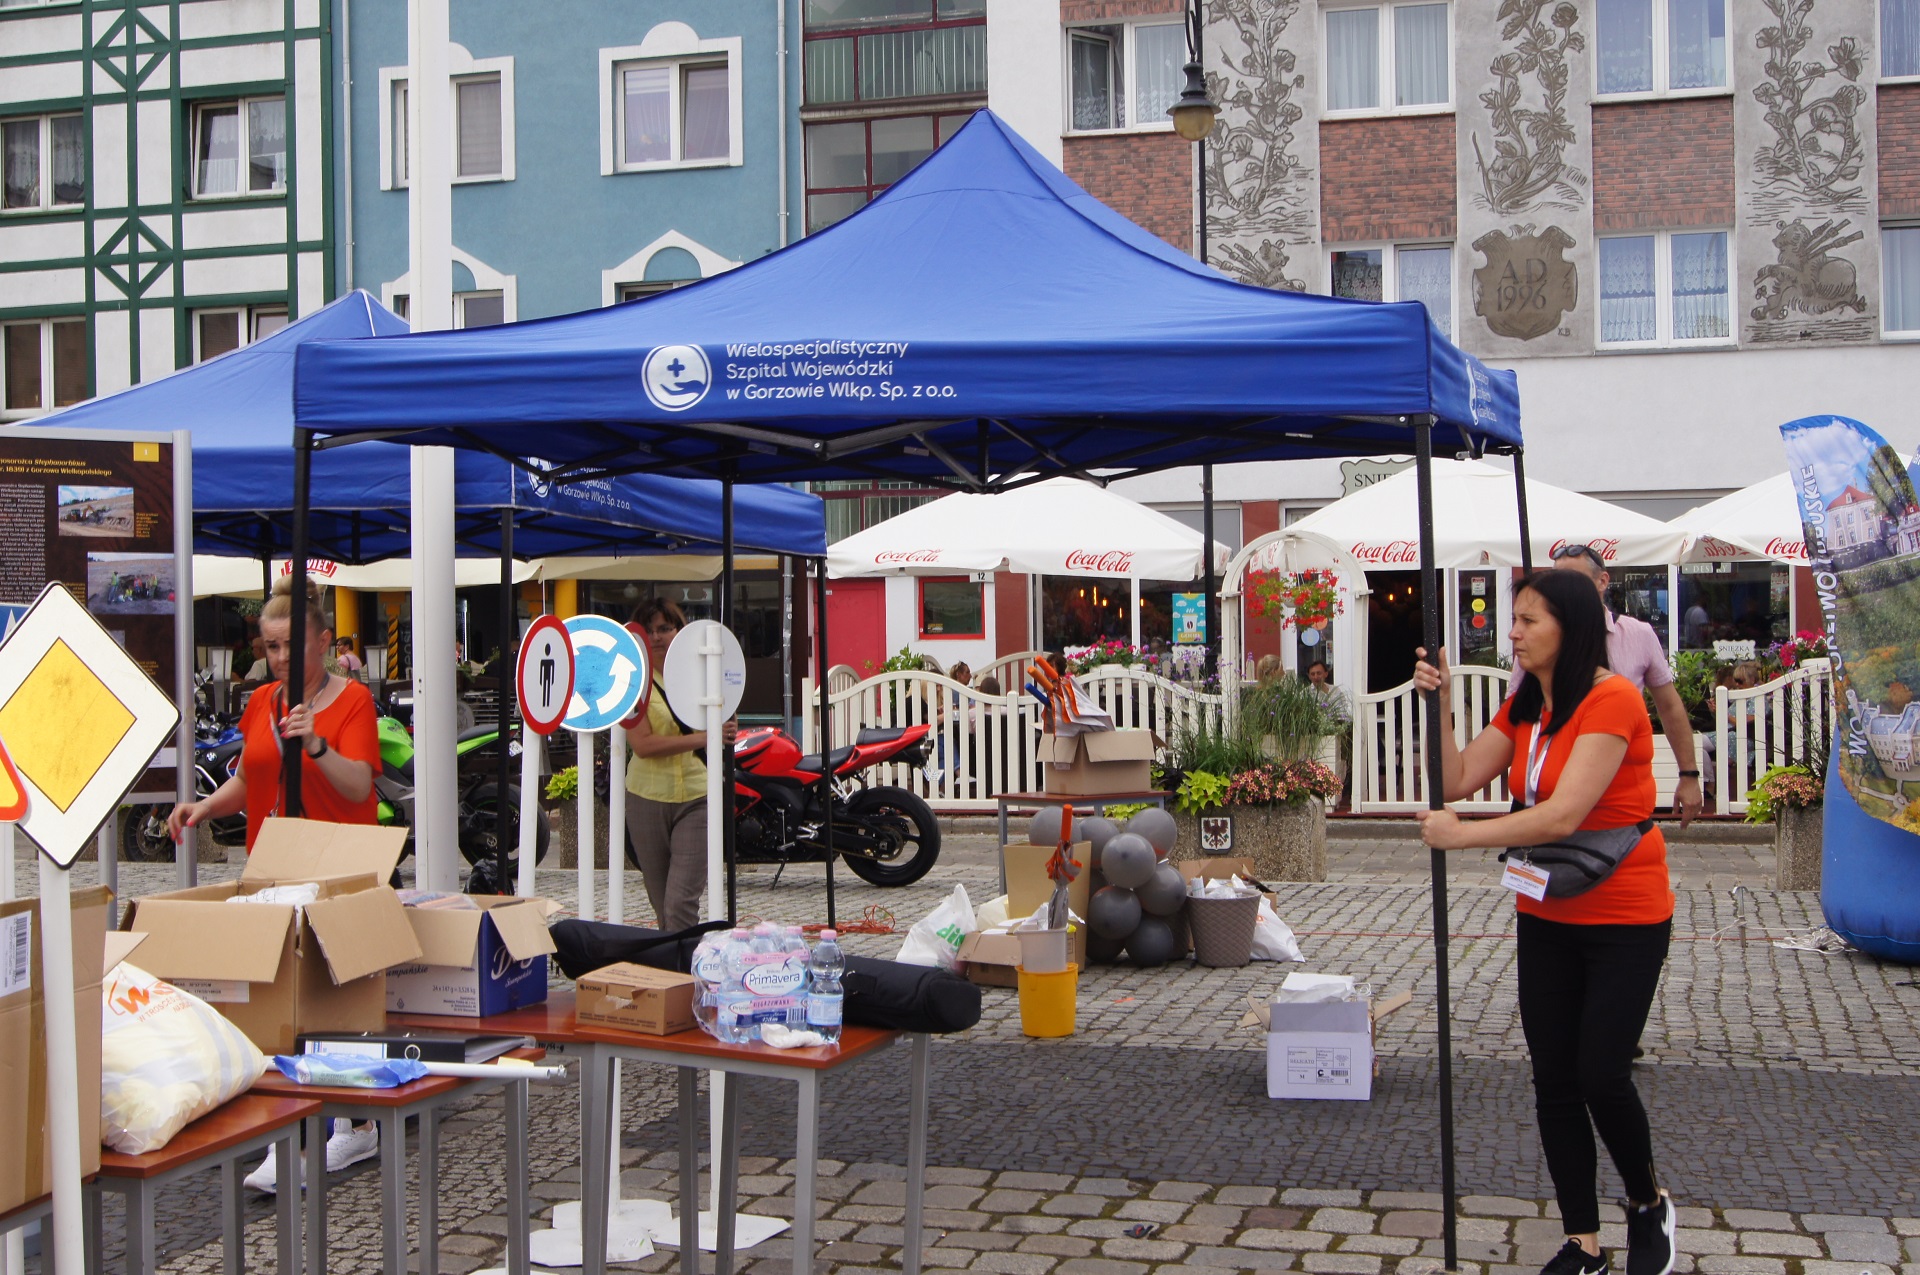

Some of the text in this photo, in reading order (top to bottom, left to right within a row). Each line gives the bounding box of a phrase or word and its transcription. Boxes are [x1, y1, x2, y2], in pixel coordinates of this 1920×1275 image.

[1496, 279, 1547, 314] 1996
[726, 339, 909, 359] Wielospecjalistyczny
[726, 359, 894, 382] Szpital Wojewódzki
[726, 381, 957, 401] w Gorzowie Wlkp. Sp. z o.o.
[563, 484, 590, 500] Gorzowie
[874, 548, 944, 564] Coca-Cola
[1065, 549, 1136, 573] Coca-Cola
[1350, 540, 1420, 564] Coca-Cola
[977, 572, 986, 580] 12
[749, 973, 800, 986] Primavera
